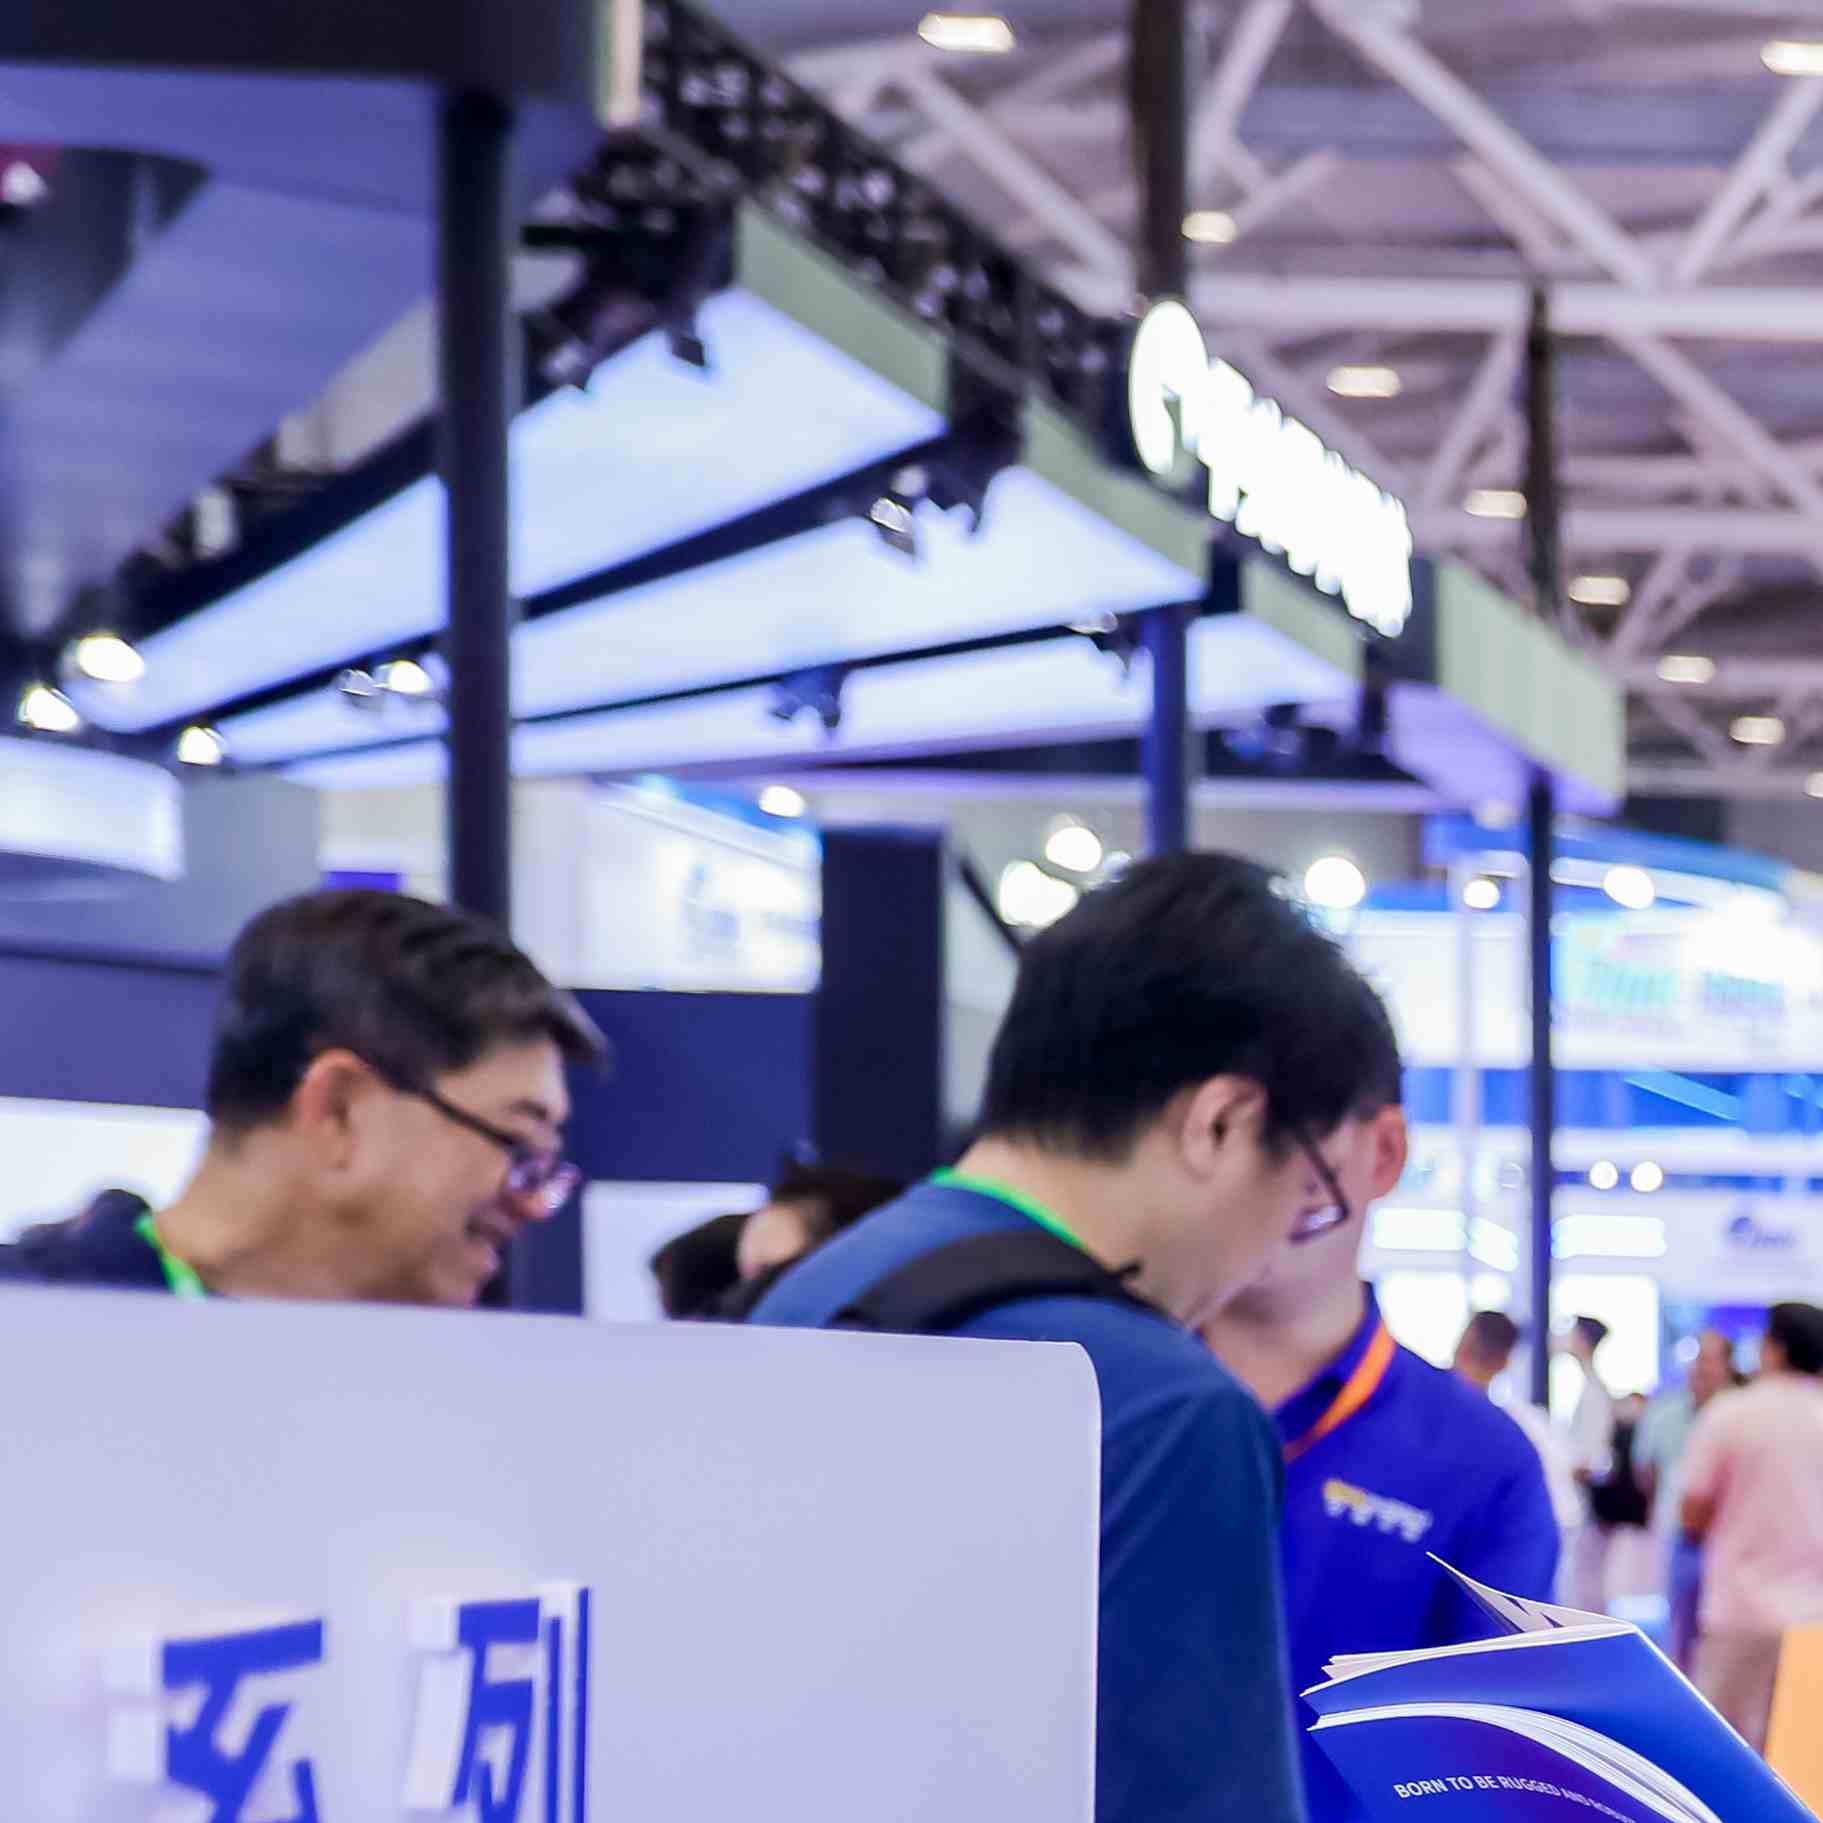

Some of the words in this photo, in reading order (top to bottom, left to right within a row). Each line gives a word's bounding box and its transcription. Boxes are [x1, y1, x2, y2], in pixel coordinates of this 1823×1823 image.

[1393, 1778, 1448, 1798] BORN
[1446, 1775, 1474, 1792] TO
[1473, 1774, 1499, 1791] BE
[1496, 1775, 1562, 1798] RUGGED
